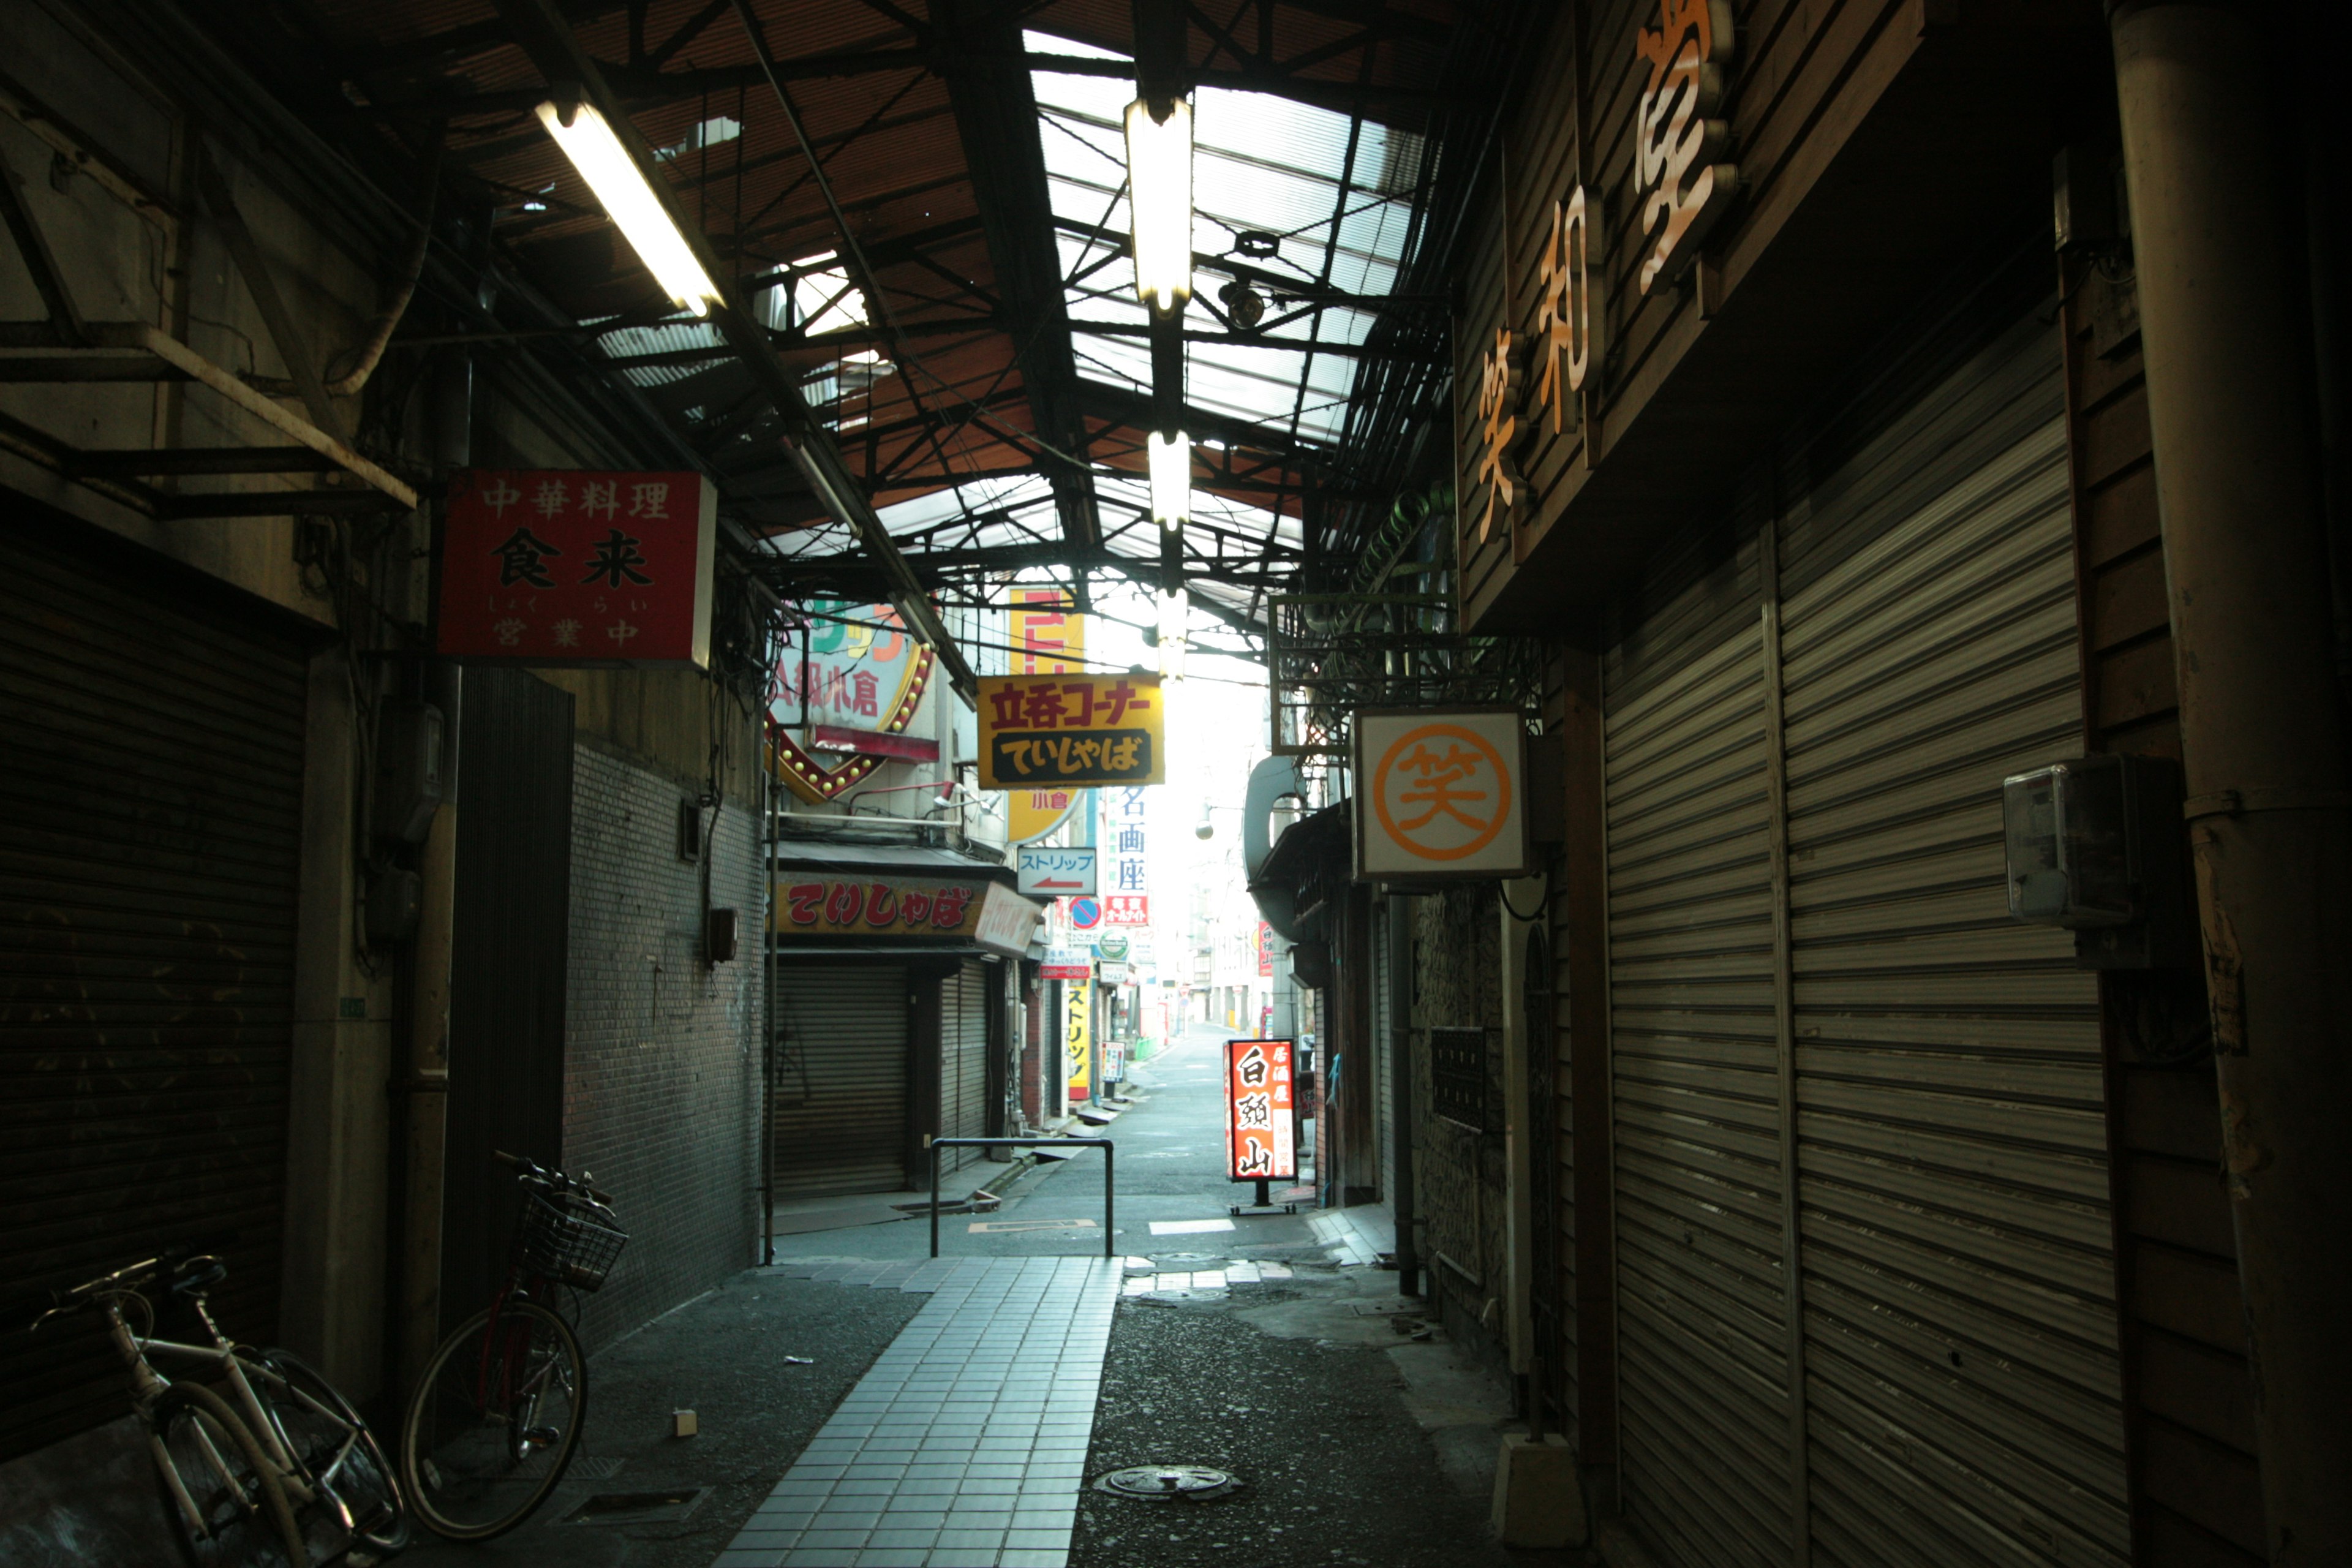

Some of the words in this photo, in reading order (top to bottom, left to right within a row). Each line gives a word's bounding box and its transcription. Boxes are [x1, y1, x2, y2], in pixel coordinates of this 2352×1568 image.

[482, 478, 669, 521] 中華料理
[491, 527, 654, 589] 食来
[493, 617, 639, 648] 営業中
[990, 682, 1150, 730] 立呑コーナー
[1000, 737, 1143, 776] ていしゃば
[1032, 791, 1068, 809] 小倉
[1398, 744, 1487, 831] 笑
[1118, 786, 1145, 891] 名画座
[1020, 855, 1094, 872] ストリップ
[788, 882, 971, 928] ていしゃば
[1107, 910, 1146, 922] オールナイト
[1069, 990, 1085, 1080] ストリップ
[1273, 1047, 1289, 1102] 居酒屋
